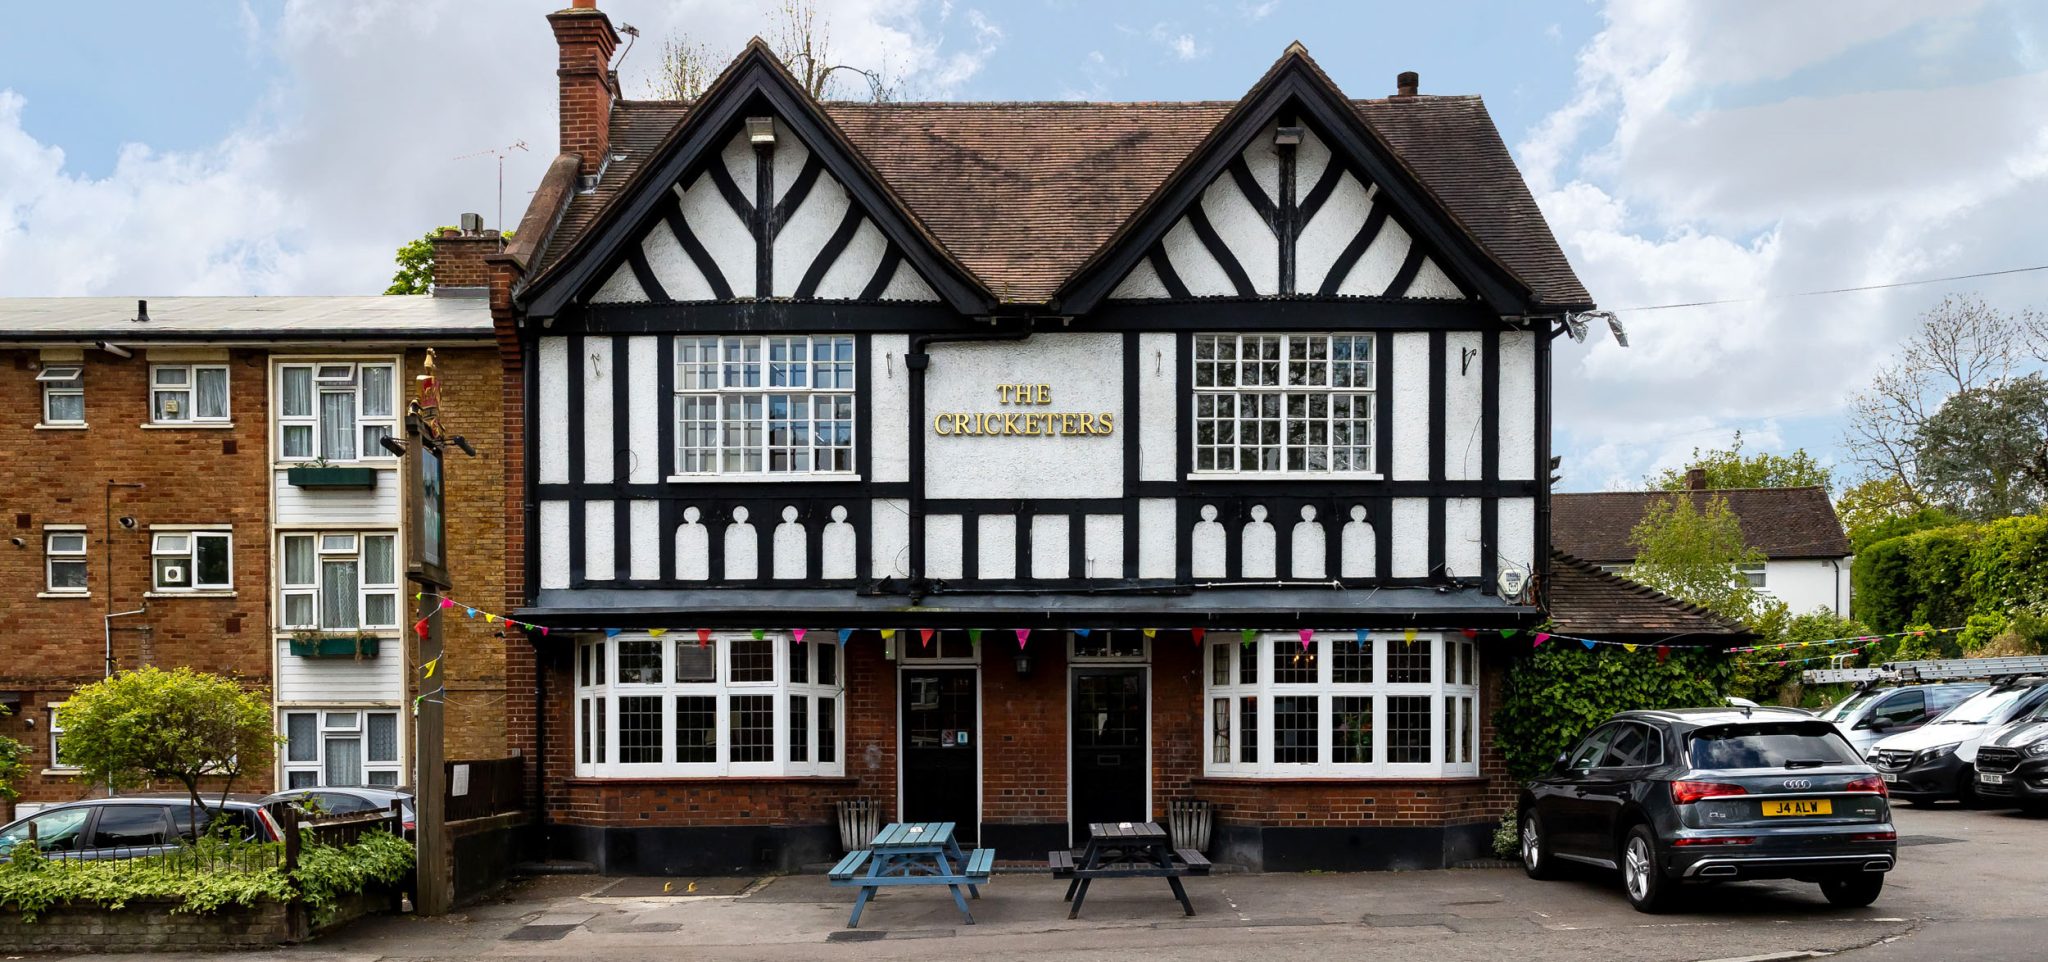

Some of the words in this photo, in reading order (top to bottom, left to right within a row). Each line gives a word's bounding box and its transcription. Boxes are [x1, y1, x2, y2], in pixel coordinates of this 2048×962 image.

[996, 383, 1051, 405] THE
[933, 412, 1114, 437] CRICKETERS
[1776, 801, 1791, 814] J4
[1795, 801, 1818, 813] ALW
